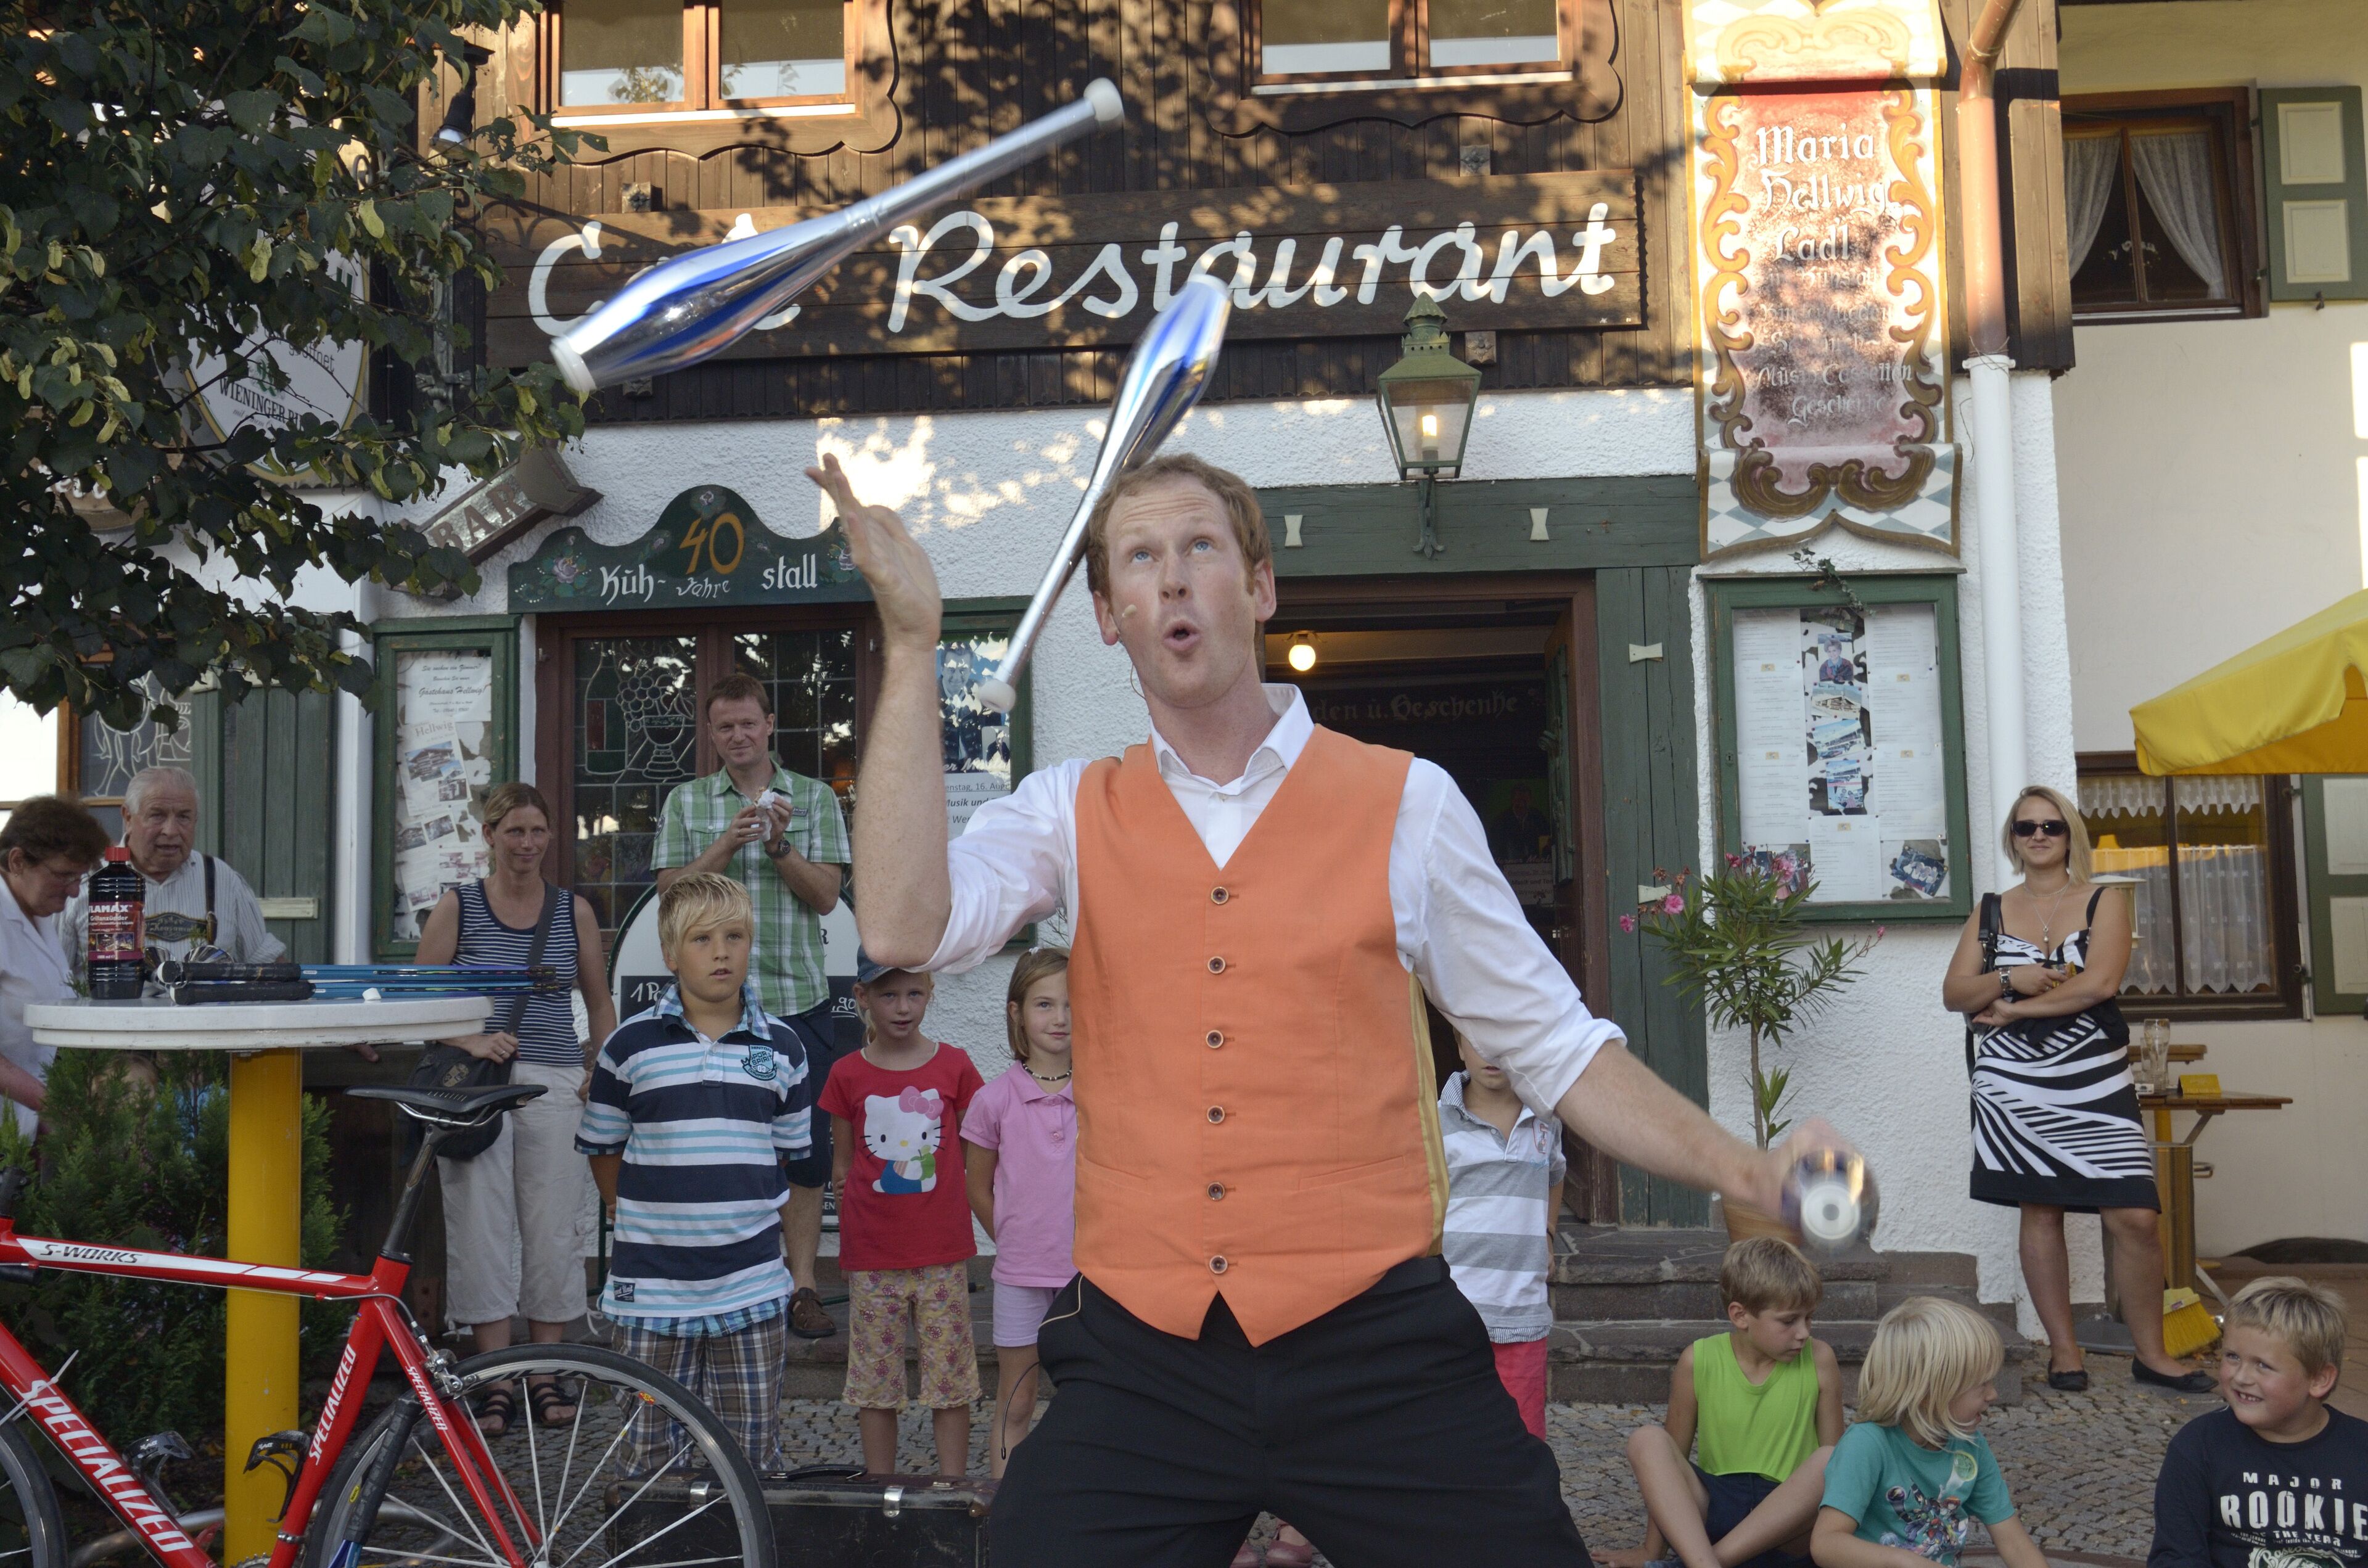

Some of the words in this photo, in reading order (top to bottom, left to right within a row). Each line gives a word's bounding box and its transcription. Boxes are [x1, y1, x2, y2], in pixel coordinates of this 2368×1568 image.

[1754, 122, 1875, 166] Maria
[1760, 168, 1892, 220] Hellwig
[887, 202, 1616, 334] Restaurant
[220, 376, 287, 425] WIENINGER
[430, 483, 526, 550] BAR
[679, 512, 745, 575] 40
[676, 577, 731, 598] Jahre
[760, 553, 818, 591] stall
[414, 721, 454, 737] Hellwig
[944, 784, 973, 792] enstag,
[990, 782, 1011, 790] Augu
[751, 1055, 772, 1065] SPIRIT
[40, 1243, 143, 1265] S-WORKS
[308, 1343, 357, 1466] SPECIALIZED
[405, 1365, 449, 1432] SPECIALIZED
[12, 1379, 194, 1553] SPECIALIZED
[2242, 1472, 2343, 1490] MAJOR
[2220, 1490, 2368, 1541] ROOKIE
[2272, 1530, 2299, 1540] THE
[2305, 1532, 2341, 1548] YEAR
